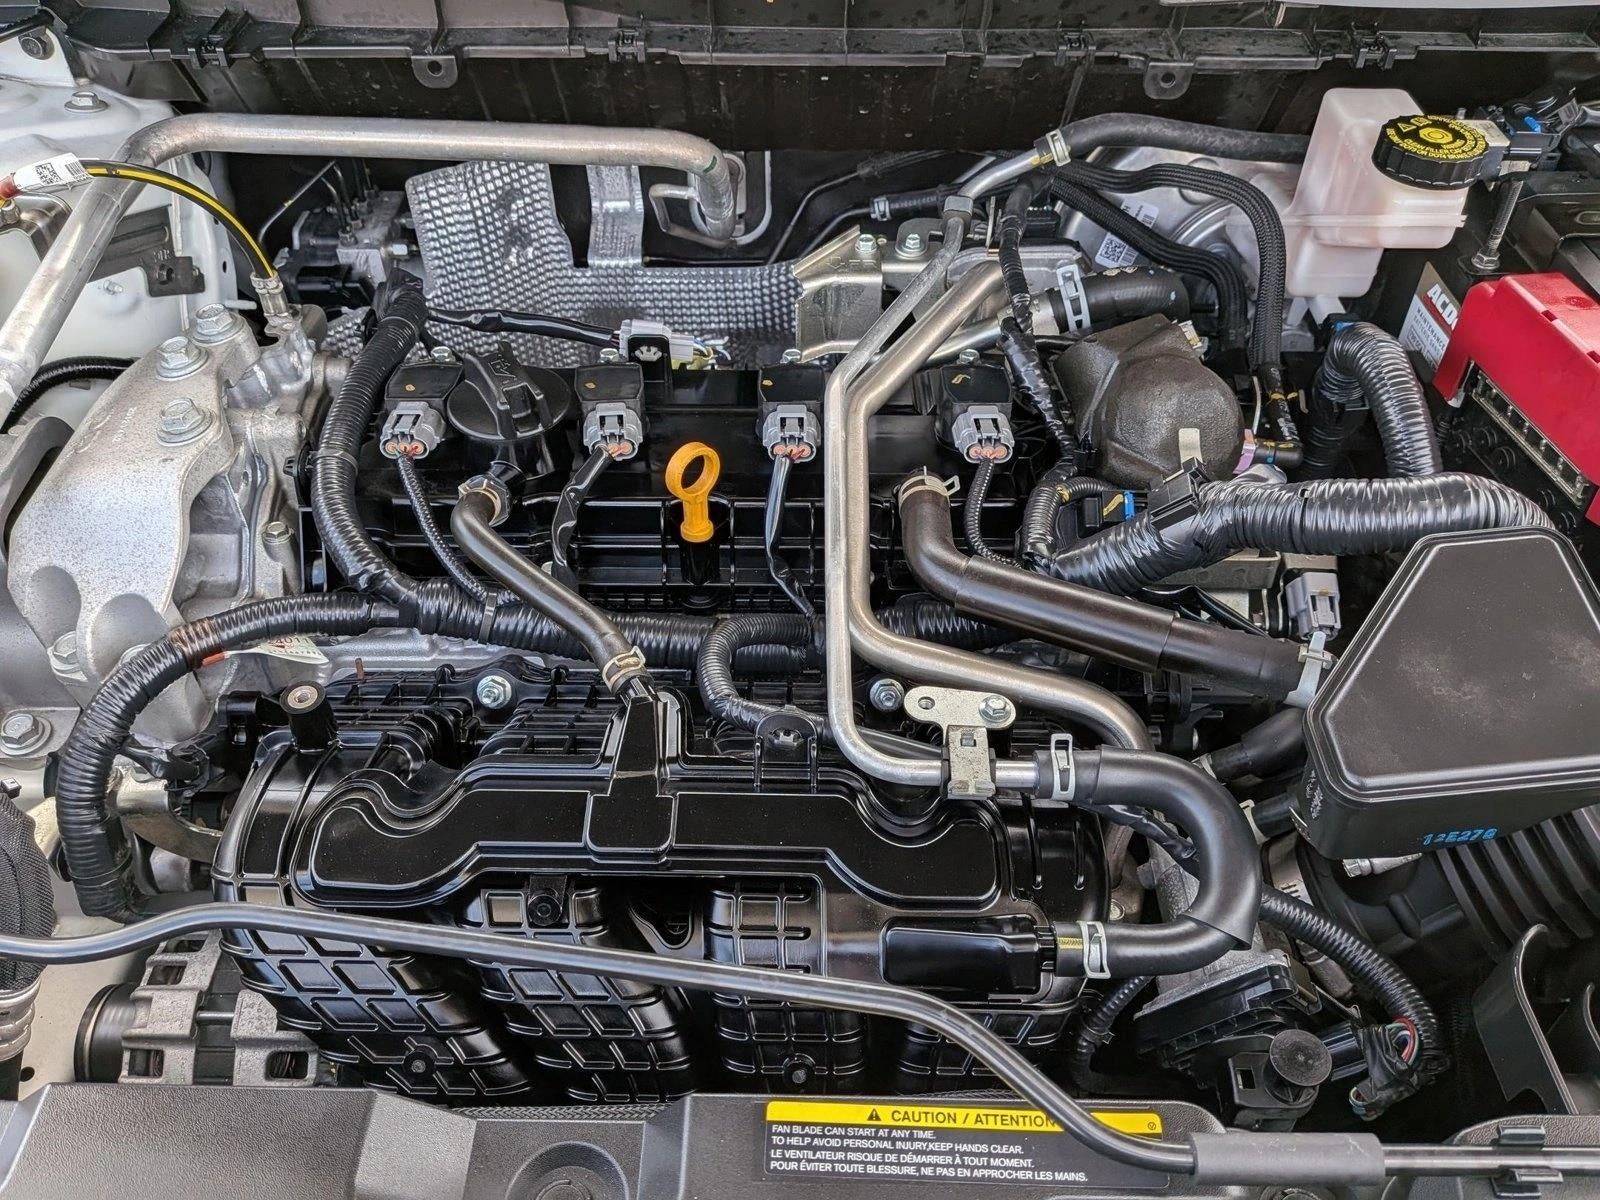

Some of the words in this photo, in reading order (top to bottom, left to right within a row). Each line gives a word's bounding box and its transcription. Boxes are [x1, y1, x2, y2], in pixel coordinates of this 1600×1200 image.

[891, 1110, 957, 1124] CAUTION
[963, 1113, 969, 1124] /
[772, 1125, 790, 1133] FAN
[792, 1126, 823, 1135] BLADE
[824, 1127, 845, 1135] CAN
[847, 1128, 876, 1137] START
[878, 1129, 889, 1137] AT
[891, 1129, 910, 1138] ANY
[912, 1130, 936, 1139] TIME.
[771, 1136, 785, 1145] TO
[786, 1137, 811, 1146] HELP
[812, 1138, 841, 1147] AVOID
[843, 1139, 894, 1149] PERSONAL
[955, 1143, 988, 1153] HANDS
[990, 1144, 1024, 1154] CLEAR.
[771, 1149, 783, 1158] LE
[784, 1150, 845, 1160] VENTILATEUR
[847, 1152, 883, 1162] RISQUE
[885, 1153, 898, 1162] DE
[900, 1152, 953, 1165] DÉMARRER
[954, 1153, 961, 1165] À
[963, 1157, 988, 1166] TOUT
[990, 1158, 1035, 1168] MOMENT.
[770, 1161, 798, 1171] POUR
[800, 1160, 832, 1171] ÉVITER
[833, 1164, 865, 1173] TOUTE
[866, 1164, 919, 1176] BLESSURE,
[921, 1167, 934, 1176] NE
[936, 1167, 955, 1177] PAS
[957, 1168, 970, 1177] EN
[972, 1168, 1032, 1179] APPROCHER
[1034, 1171, 1053, 1180] LES
[1055, 1172, 1088, 1182] MAINS.
